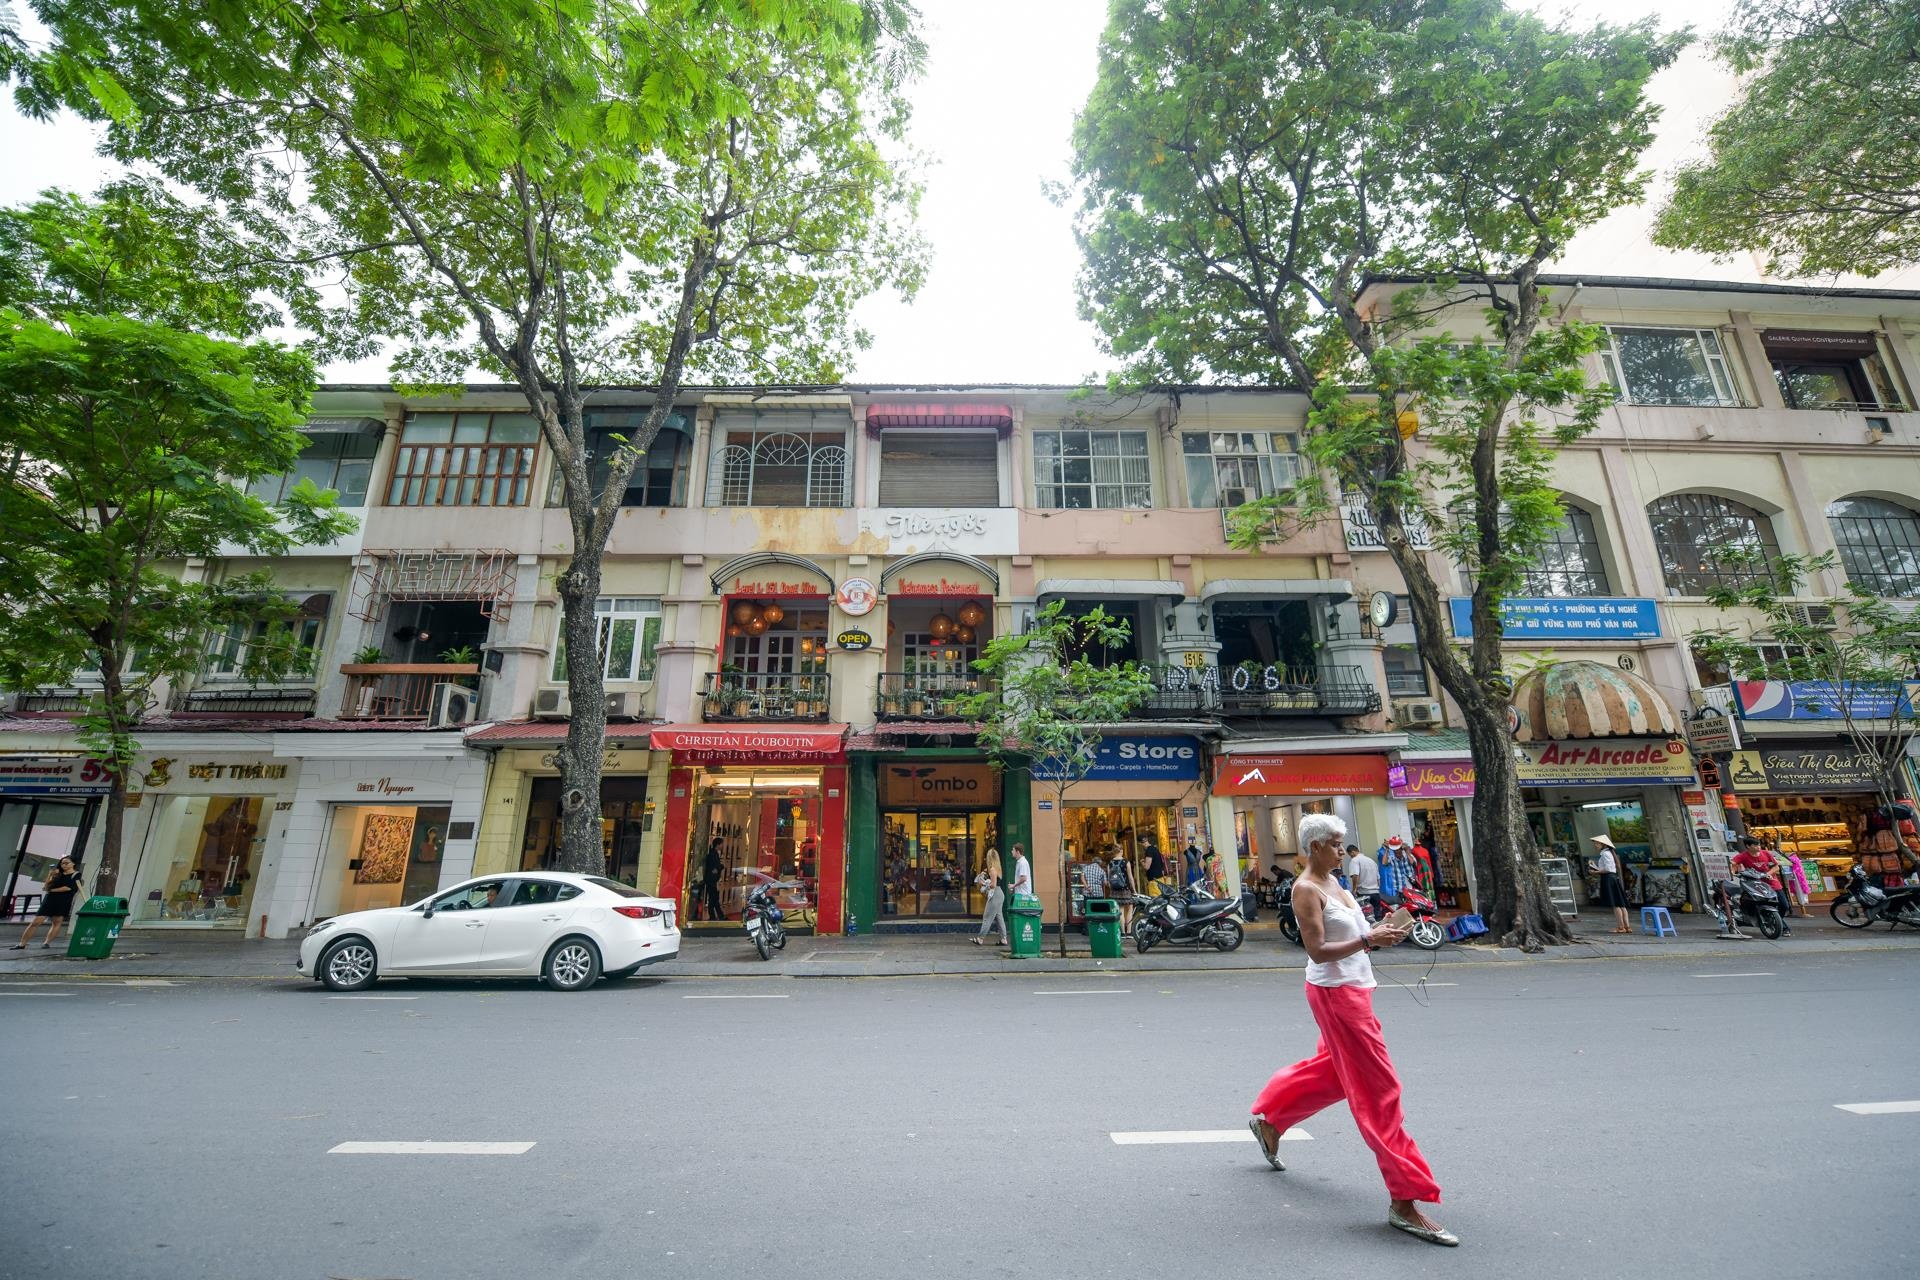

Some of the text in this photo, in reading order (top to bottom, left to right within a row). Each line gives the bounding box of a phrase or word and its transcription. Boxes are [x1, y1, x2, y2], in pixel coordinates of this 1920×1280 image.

[1534, 602, 1550, 613] PHỐ
[1552, 605, 1558, 613] 5
[1567, 620, 1583, 628] KHU
[1585, 618, 1601, 628] PHỐ
[839, 634, 869, 643] OPEN
[1693, 719, 1723, 730] THE OLIVE
[1690, 727, 1729, 737] STEAKHOUSE
[675, 734, 815, 747] CHRISTIAN LOUBOUTIN
[1119, 742, 1194, 759] Store
[1538, 742, 1669, 765] Art Arcade
[1798, 754, 1822, 771] Thị
[1824, 754, 1852, 772] Quà
[275, 801, 293, 811] 137
